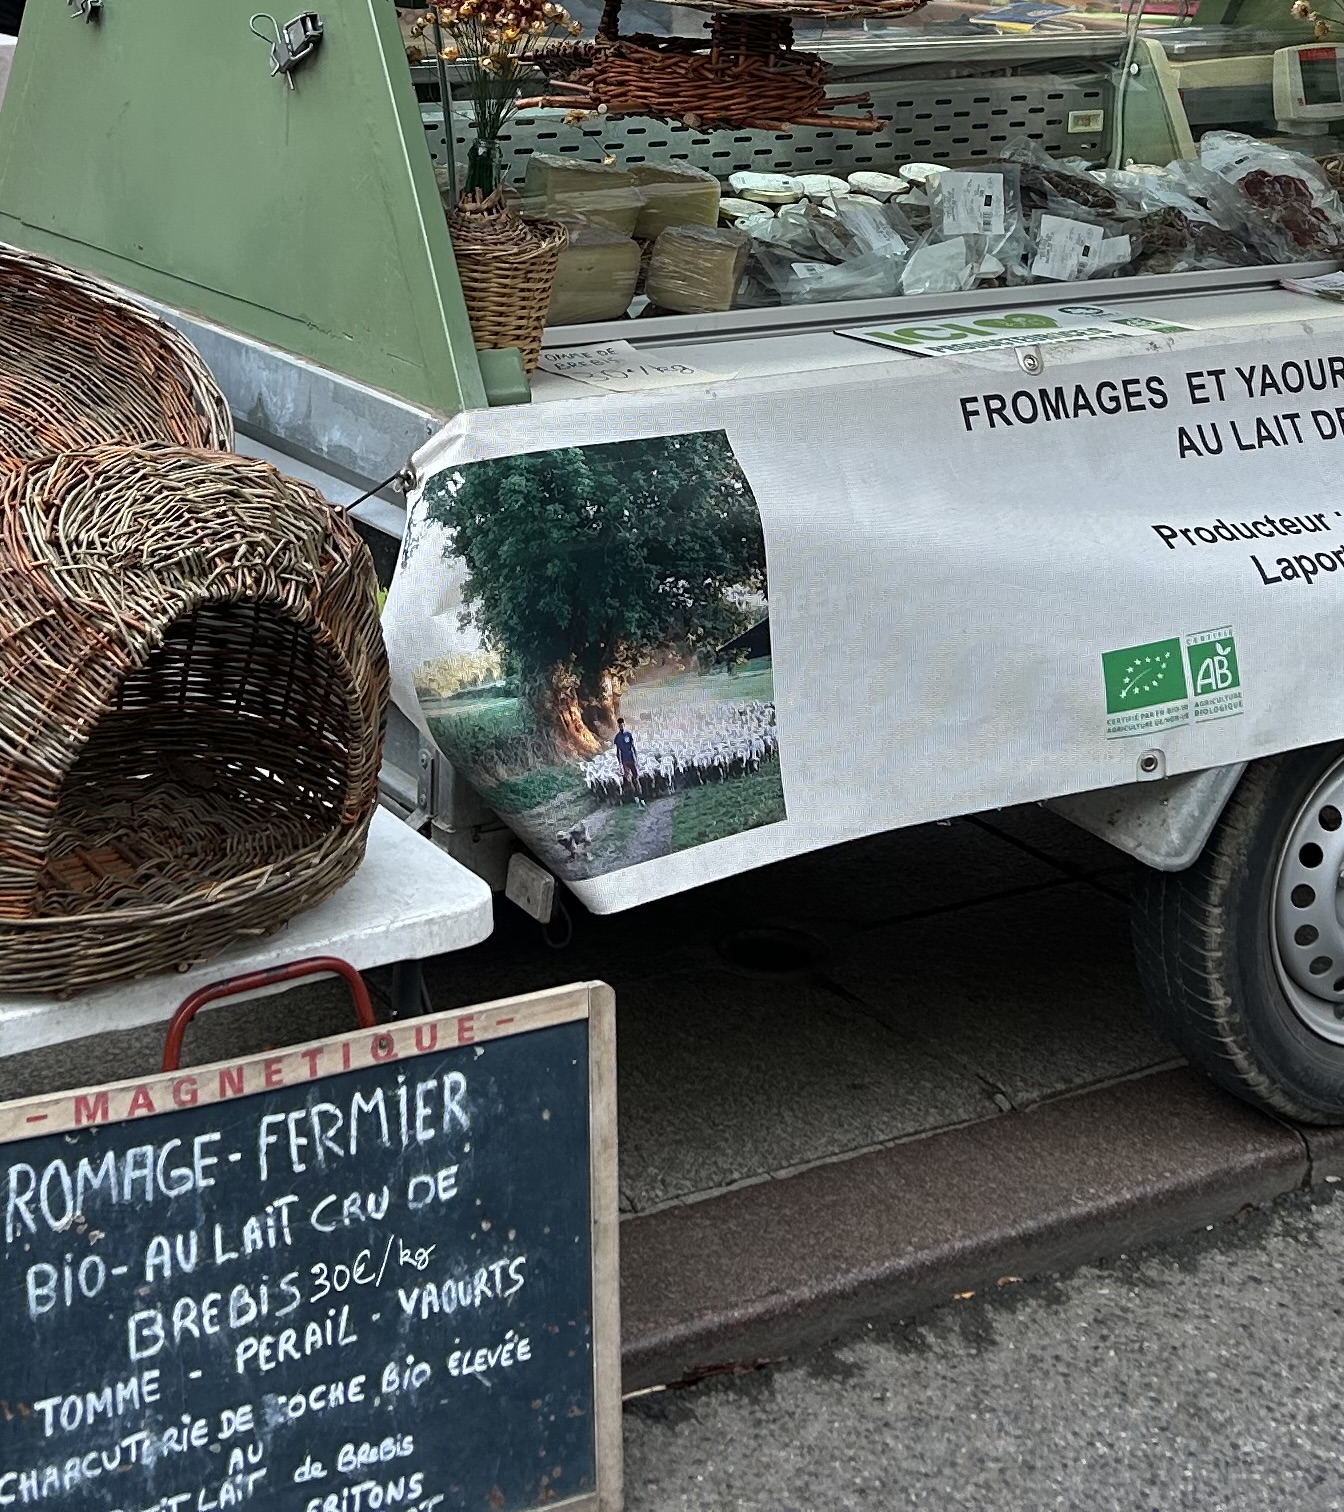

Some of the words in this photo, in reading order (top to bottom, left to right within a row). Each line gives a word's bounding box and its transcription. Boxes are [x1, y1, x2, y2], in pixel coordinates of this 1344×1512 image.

[544, 352, 593, 362] OMME
[864, 322, 997, 346] ICI
[960, 374, 1170, 432] FROMAGES
[1186, 370, 1231, 406] ET
[1175, 420, 1225, 460] AU
[1232, 409, 1306, 454] LAIT
[1152, 506, 1335, 554] Producteur
[1197, 655, 1232, 694] AB
[73, 1014, 478, 1126] MAGNETIQUE
[144, 1232, 198, 1285] AU
[214, 1192, 298, 1264] LAIT
[309, 1190, 389, 1232] CRU
[407, 1164, 459, 1210] DE
[128, 1269, 302, 1363] BREBIS
[34, 1369, 161, 1438] TOMME
[236, 1304, 358, 1375] PERAIL
[218, 1404, 254, 1440] DE
[228, 1440, 264, 1477] AU
